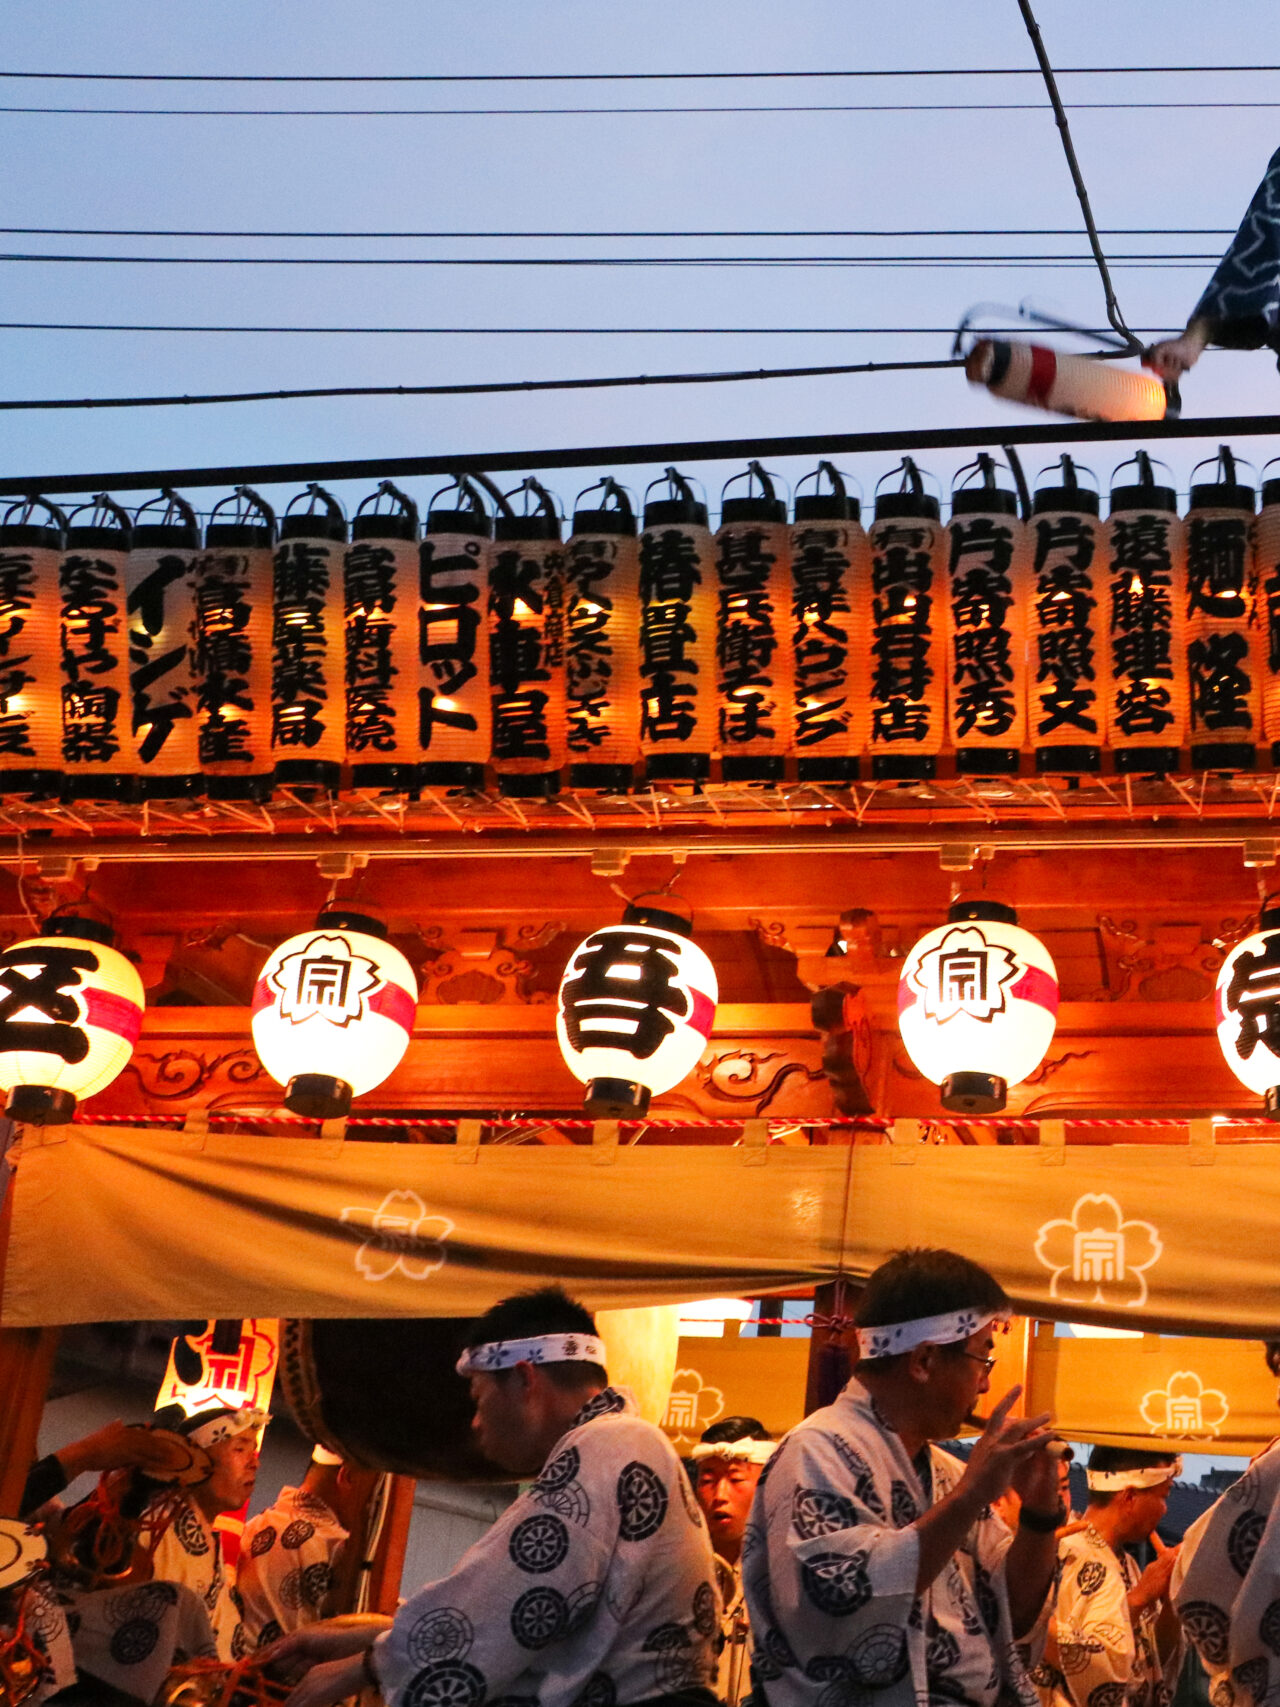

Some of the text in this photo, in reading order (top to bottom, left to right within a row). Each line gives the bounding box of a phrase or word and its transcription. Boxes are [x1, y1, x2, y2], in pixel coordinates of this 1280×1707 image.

[273, 543, 330, 748] 藤屋薬局
[419, 541, 480, 750] ピロット
[639, 529, 702, 742] 椿畳店
[716, 528, 778, 744] 甚兵衛そば
[949, 518, 1016, 738] 片寄照秀
[1034, 515, 1097, 736] 片寄照文
[1110, 514, 1174, 736] 遠藤理容
[561, 930, 690, 1060] 吾
